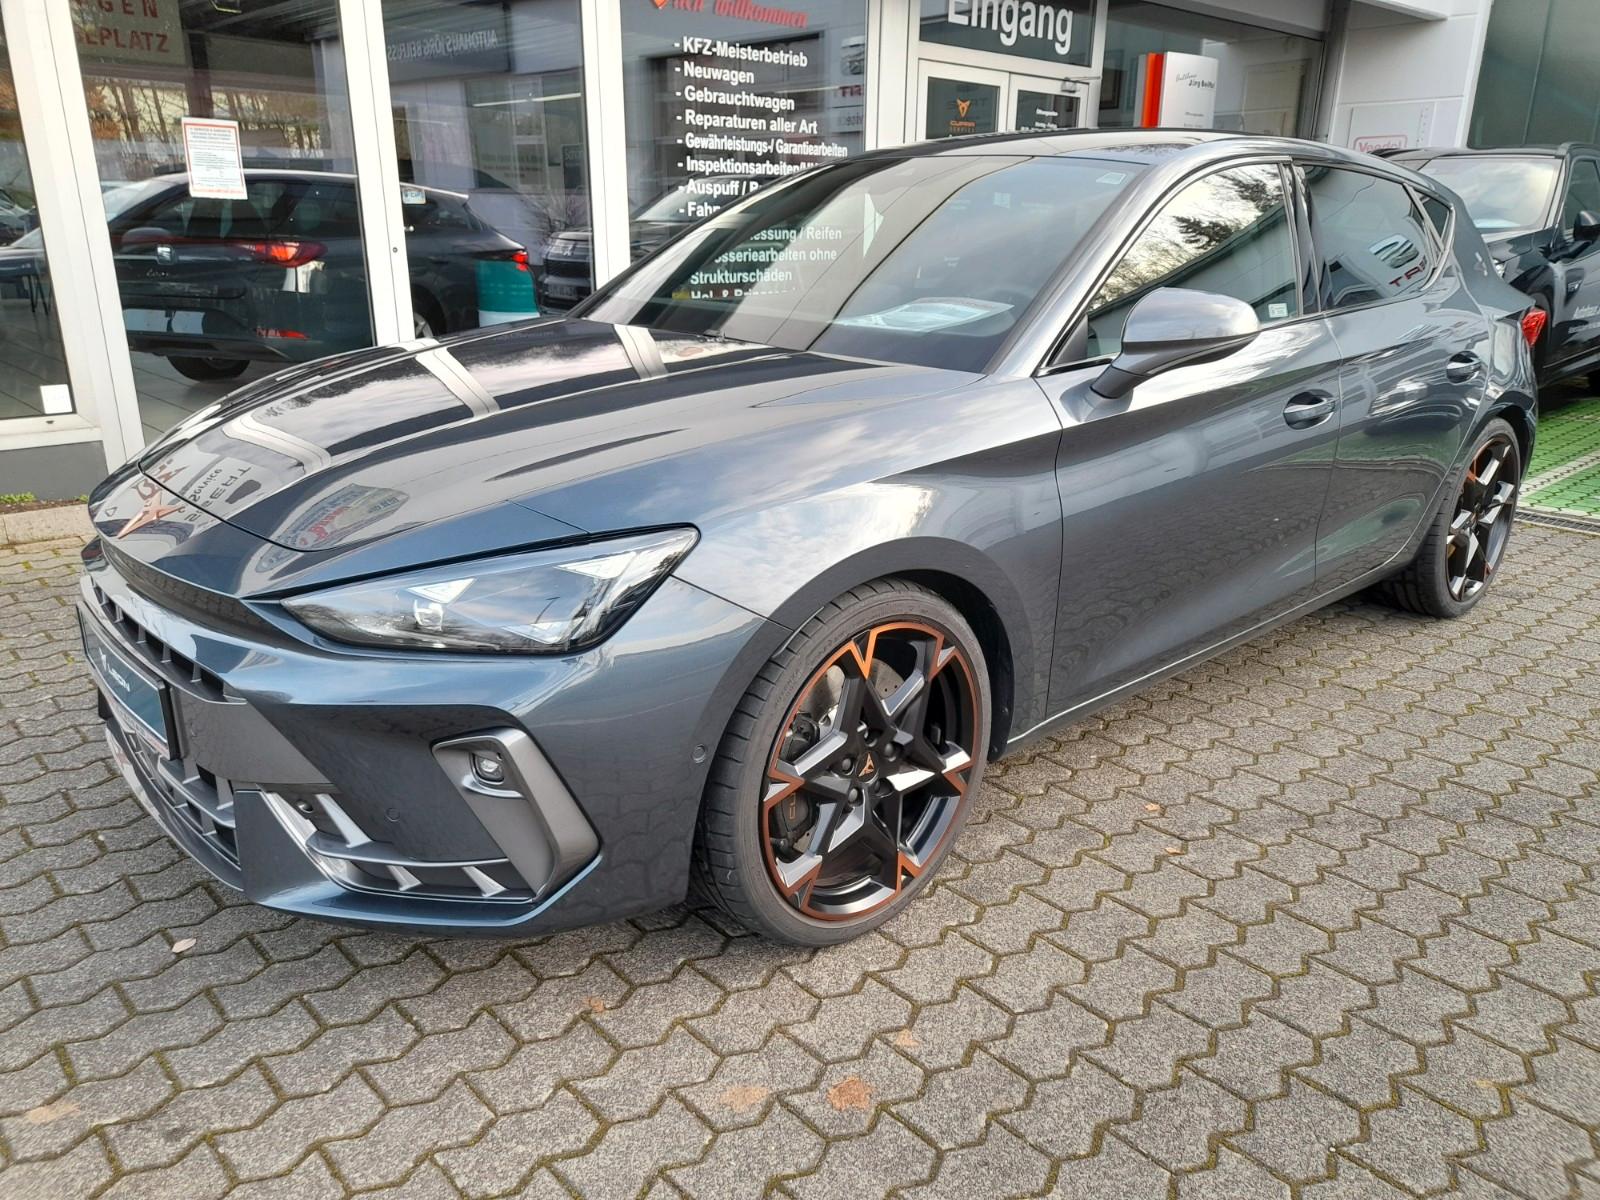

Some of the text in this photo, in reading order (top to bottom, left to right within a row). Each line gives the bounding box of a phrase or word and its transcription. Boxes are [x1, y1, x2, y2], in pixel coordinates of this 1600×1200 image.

[948, 0, 1073, 55] Eingang
[683, 36, 808, 67] KFZ-Meisterbetrieb
[684, 61, 754, 86] Neuwagen
[684, 85, 795, 112] Gebrauchtwagen
[685, 109, 766, 129] Reparaturen
[769, 117, 796, 133] aller
[799, 119, 818, 134] Art
[776, 140, 848, 158] Garantiearbeiten
[687, 178, 740, 198] Auspuff
[750, 228, 797, 242] essung
[806, 226, 842, 240] Reifen
[809, 248, 837, 261] ohne
[690, 268, 792, 285] Strukturschäden
